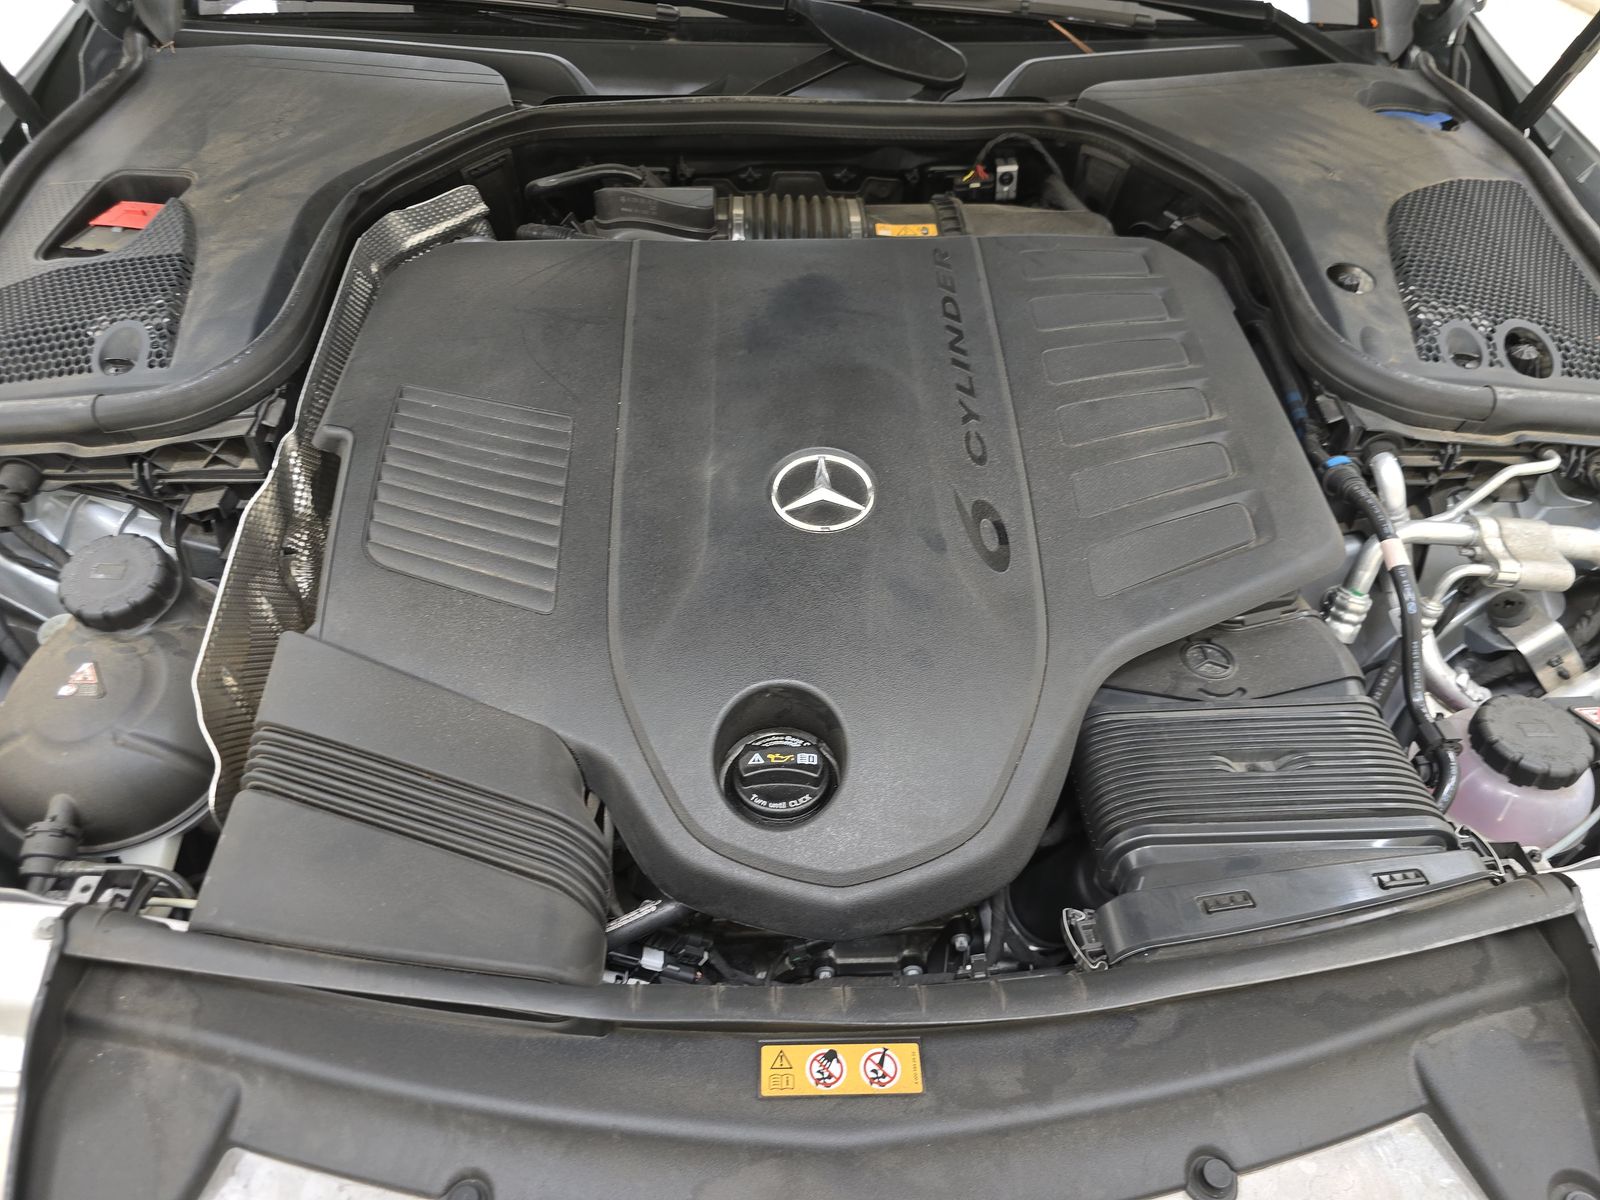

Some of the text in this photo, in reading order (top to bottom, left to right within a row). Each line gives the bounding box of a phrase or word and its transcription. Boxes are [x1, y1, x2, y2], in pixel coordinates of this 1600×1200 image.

[933, 248, 1011, 574] 6 CYLINDER
[750, 793, 767, 806] Turn
[788, 794, 812, 808] CLICK
